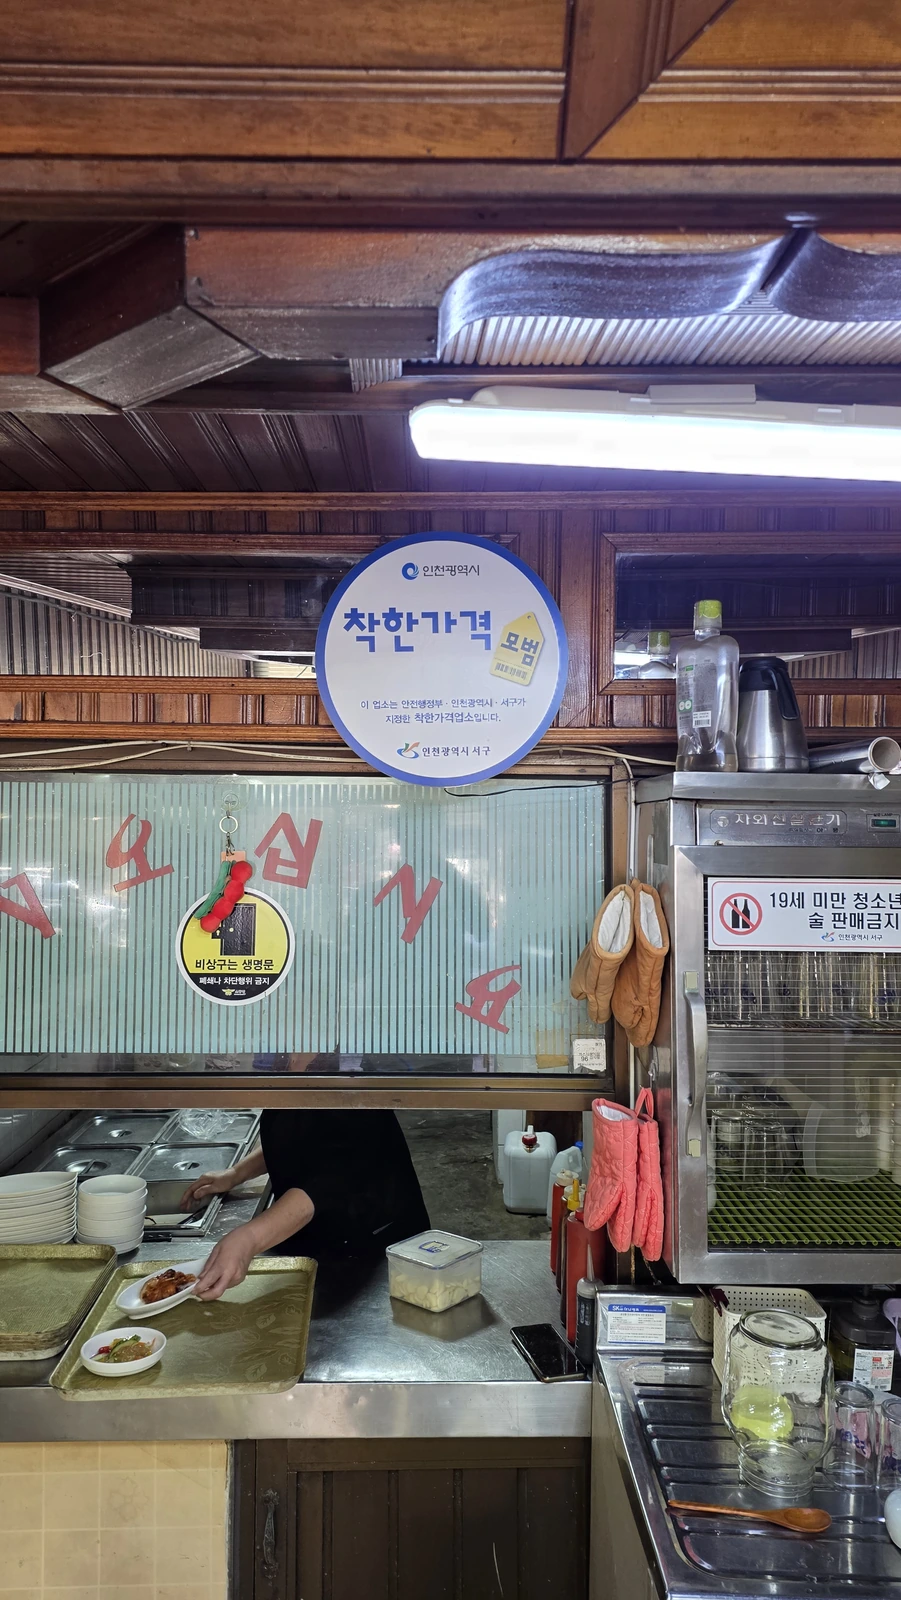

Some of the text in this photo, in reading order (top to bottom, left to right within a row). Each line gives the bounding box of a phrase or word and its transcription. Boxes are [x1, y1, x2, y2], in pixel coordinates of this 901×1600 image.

[422, 564, 480, 577] 인천광역시
[343, 607, 492, 653] 착한가격
[500, 631, 540, 668] 모범
[360, 698, 526, 710] 이 업소는 안전행정부 인천광역시 서구가
[385, 712, 501, 724] 지정한 착한가격업소입니다.
[422, 746, 491, 757] 인천광역시 서구
[769, 892, 901, 910] 19세 미만 청소년
[808, 912, 899, 930] 술 판매금지
[838, 934, 869, 942] 인천광역시
[195, 959, 274, 971] 비상구는 생명문
[199, 976, 270, 985] 폐쇄나 차단행위 금지
